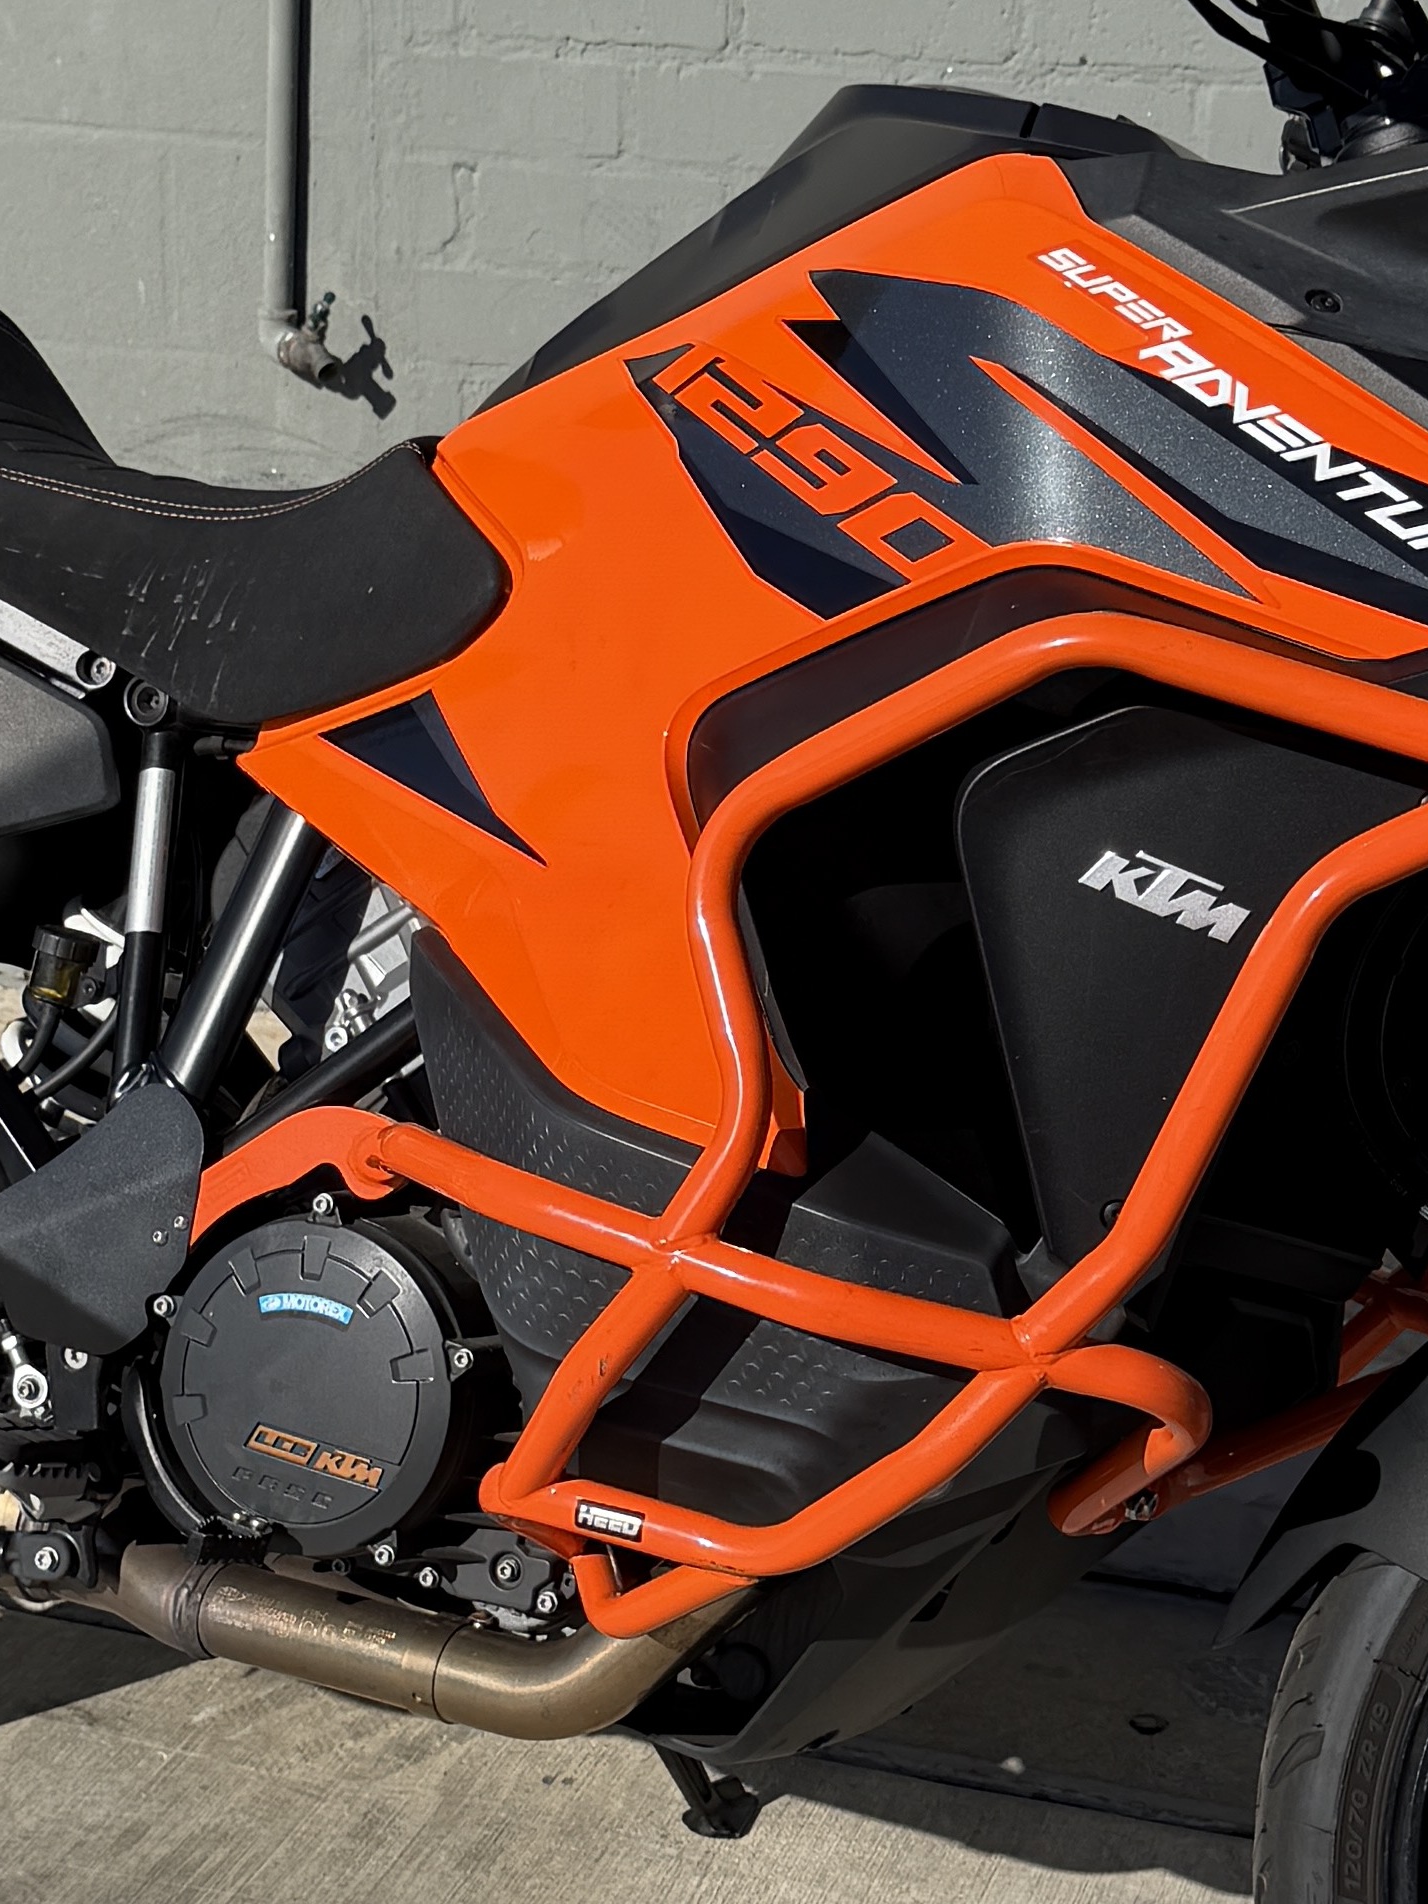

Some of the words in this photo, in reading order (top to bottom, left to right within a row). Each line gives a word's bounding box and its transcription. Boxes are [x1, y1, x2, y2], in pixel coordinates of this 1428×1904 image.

[1036, 246, 1194, 342] SUPER
[654, 342, 996, 584] 1290
[1078, 850, 1250, 943] KTM
[281, 1293, 347, 1324] MOTOREX
[312, 1449, 384, 1489] KTM
[578, 1505, 643, 1536] HEED
[1343, 1790, 1370, 1891] 120/70
[1357, 1740, 1380, 1781] ZR
[1369, 1701, 1391, 1736] 19
